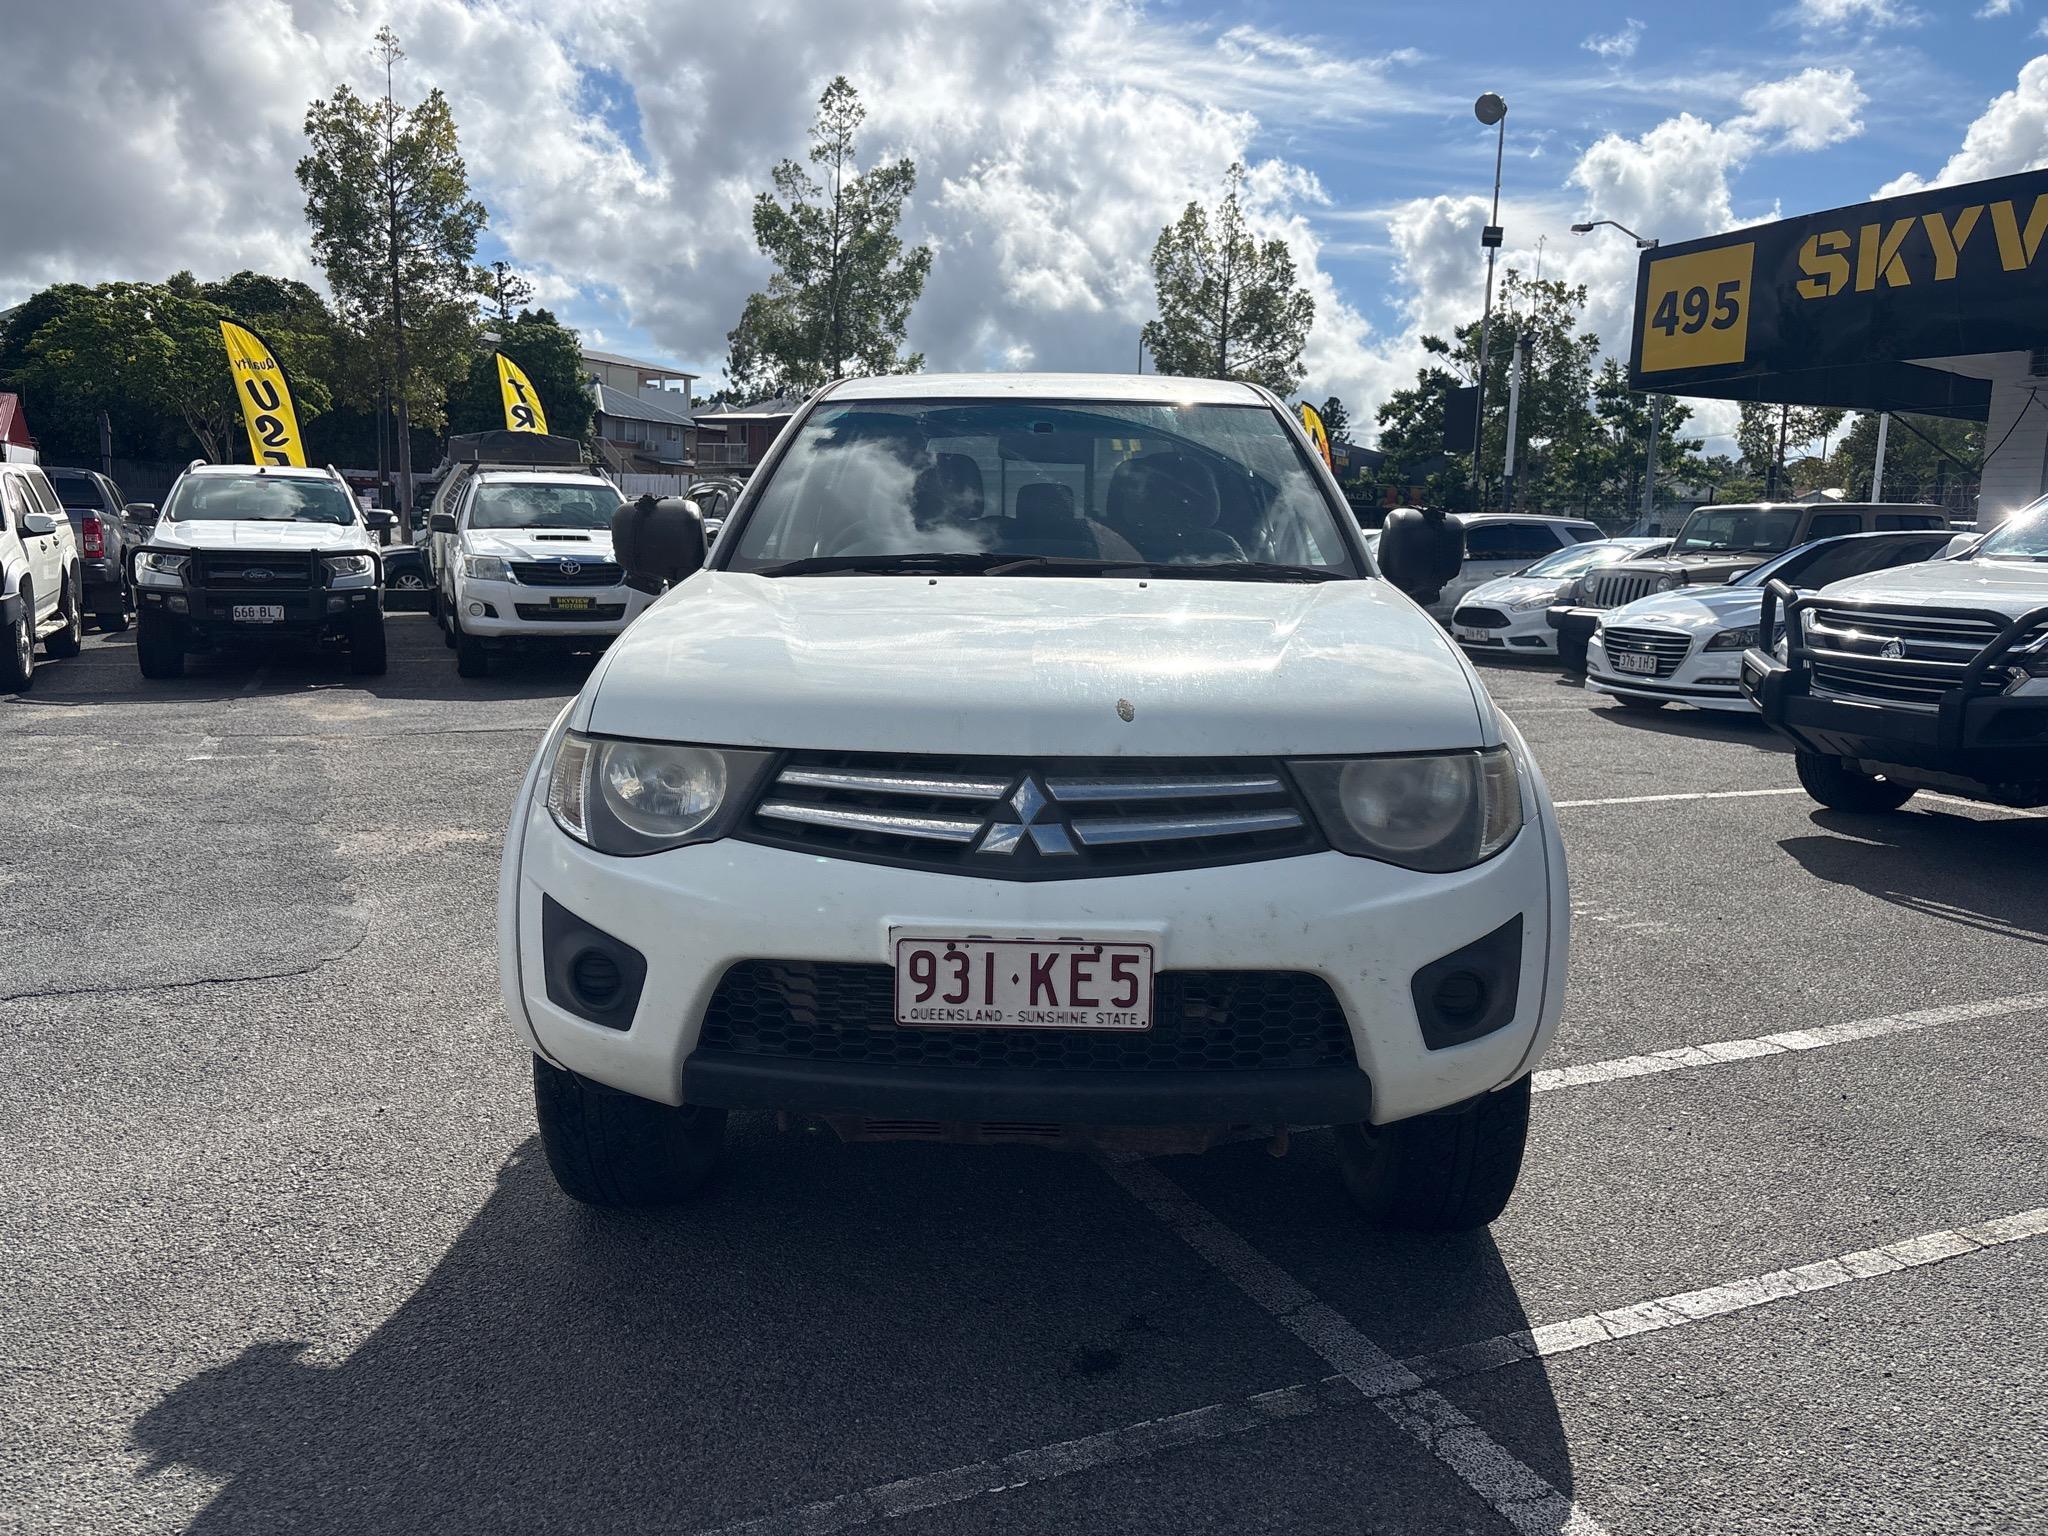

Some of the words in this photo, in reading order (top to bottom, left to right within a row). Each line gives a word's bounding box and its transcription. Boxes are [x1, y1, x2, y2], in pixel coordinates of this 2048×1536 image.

[1651, 280, 1741, 337] 495
[910, 1008, 1003, 1022] QUEENSLAND
[1017, 1010, 1088, 1024] SUNSHINE
[1095, 1012, 1138, 1026] STATE
